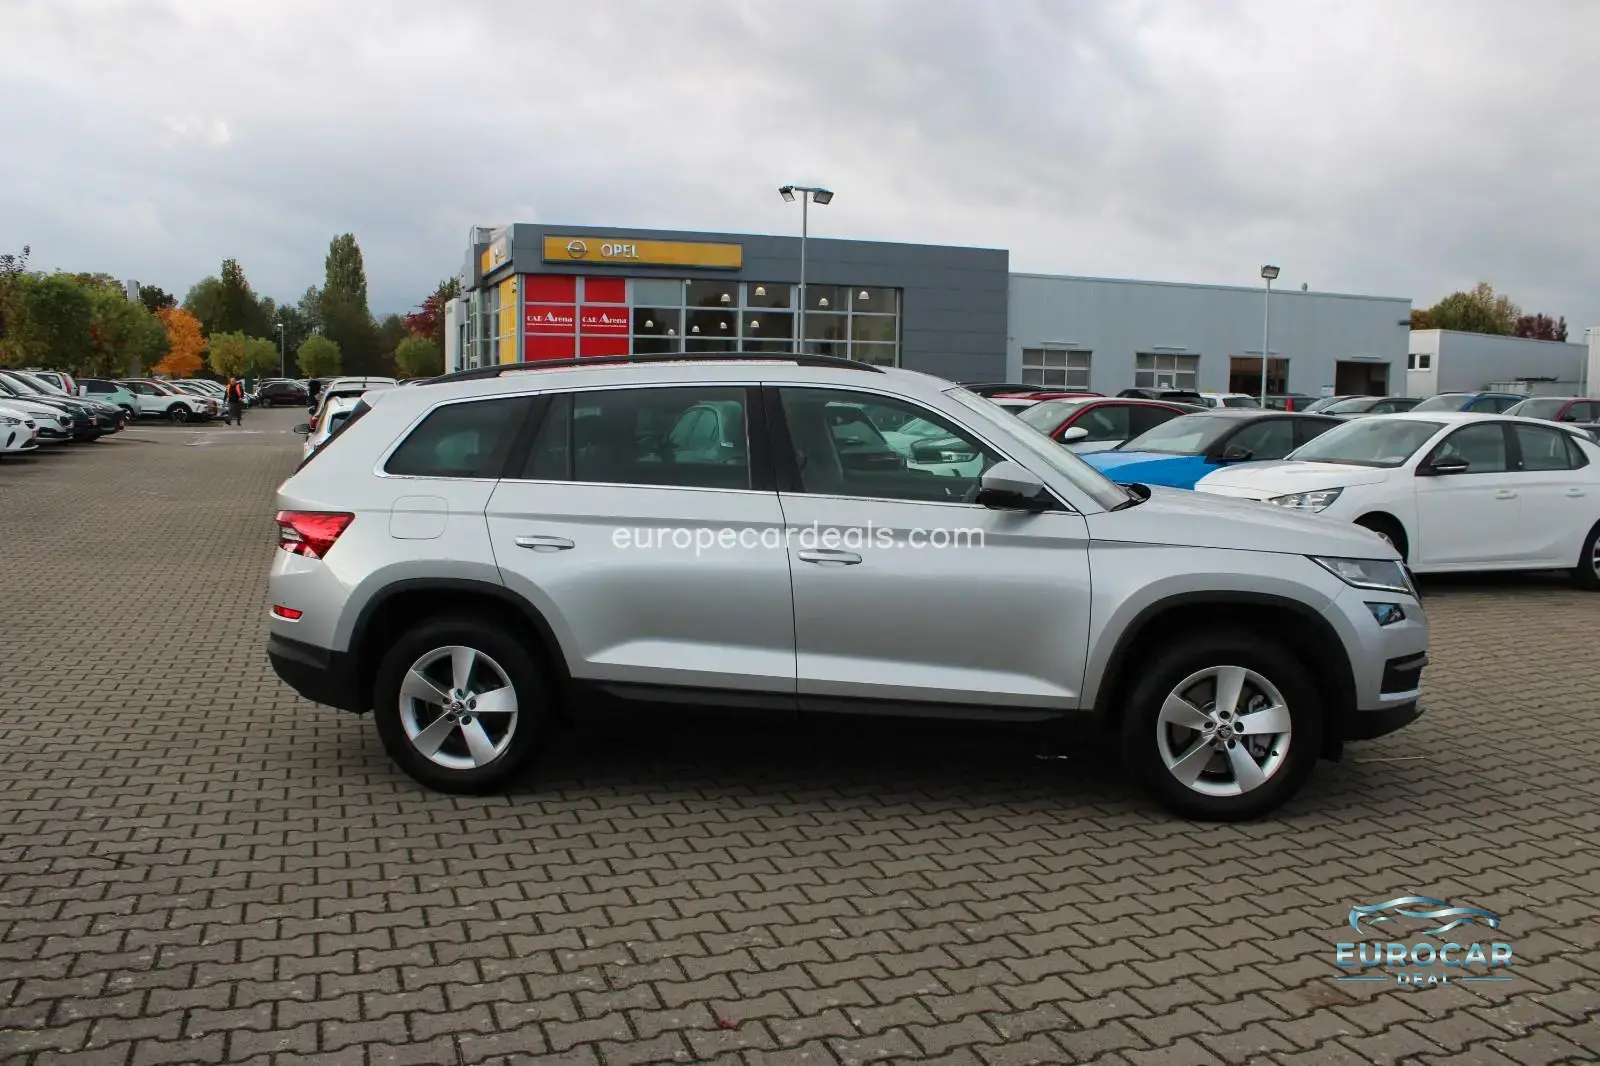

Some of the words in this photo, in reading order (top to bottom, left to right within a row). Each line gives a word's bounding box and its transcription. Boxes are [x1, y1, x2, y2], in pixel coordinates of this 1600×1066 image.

[601, 243, 639, 258] OPEL
[544, 311, 573, 323] Arena
[599, 312, 627, 324] Arena
